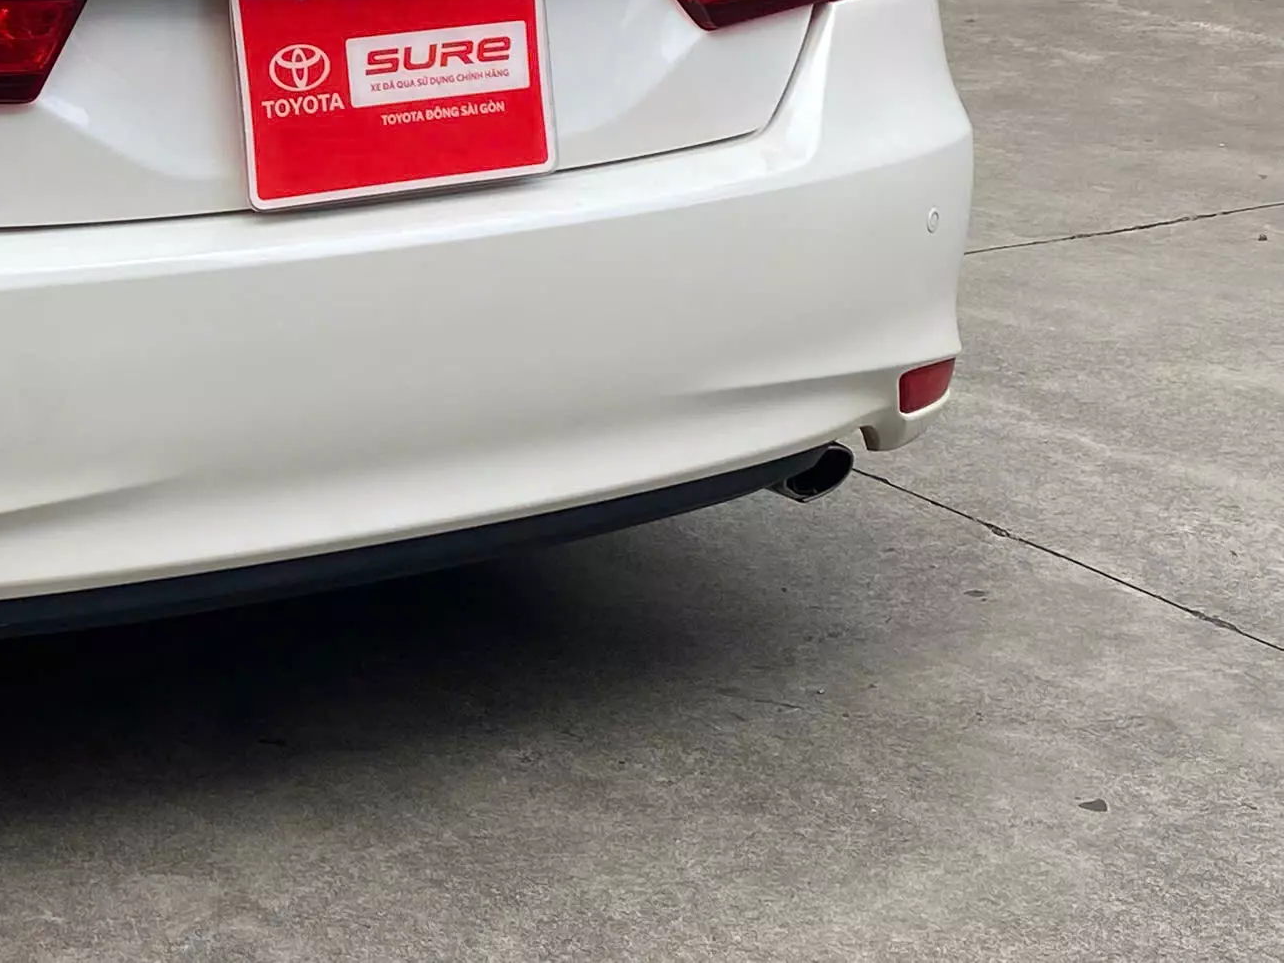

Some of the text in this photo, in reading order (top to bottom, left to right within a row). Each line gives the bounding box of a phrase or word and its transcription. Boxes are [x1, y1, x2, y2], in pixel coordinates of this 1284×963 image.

[370, 81, 382, 93] XE
[396, 78, 416, 89] QUA
[456, 69, 484, 82] CHÍNH
[261, 92, 346, 119] TOYOTA
[380, 99, 506, 126] TOYOTA ĐÔNG SÀI GÒN
